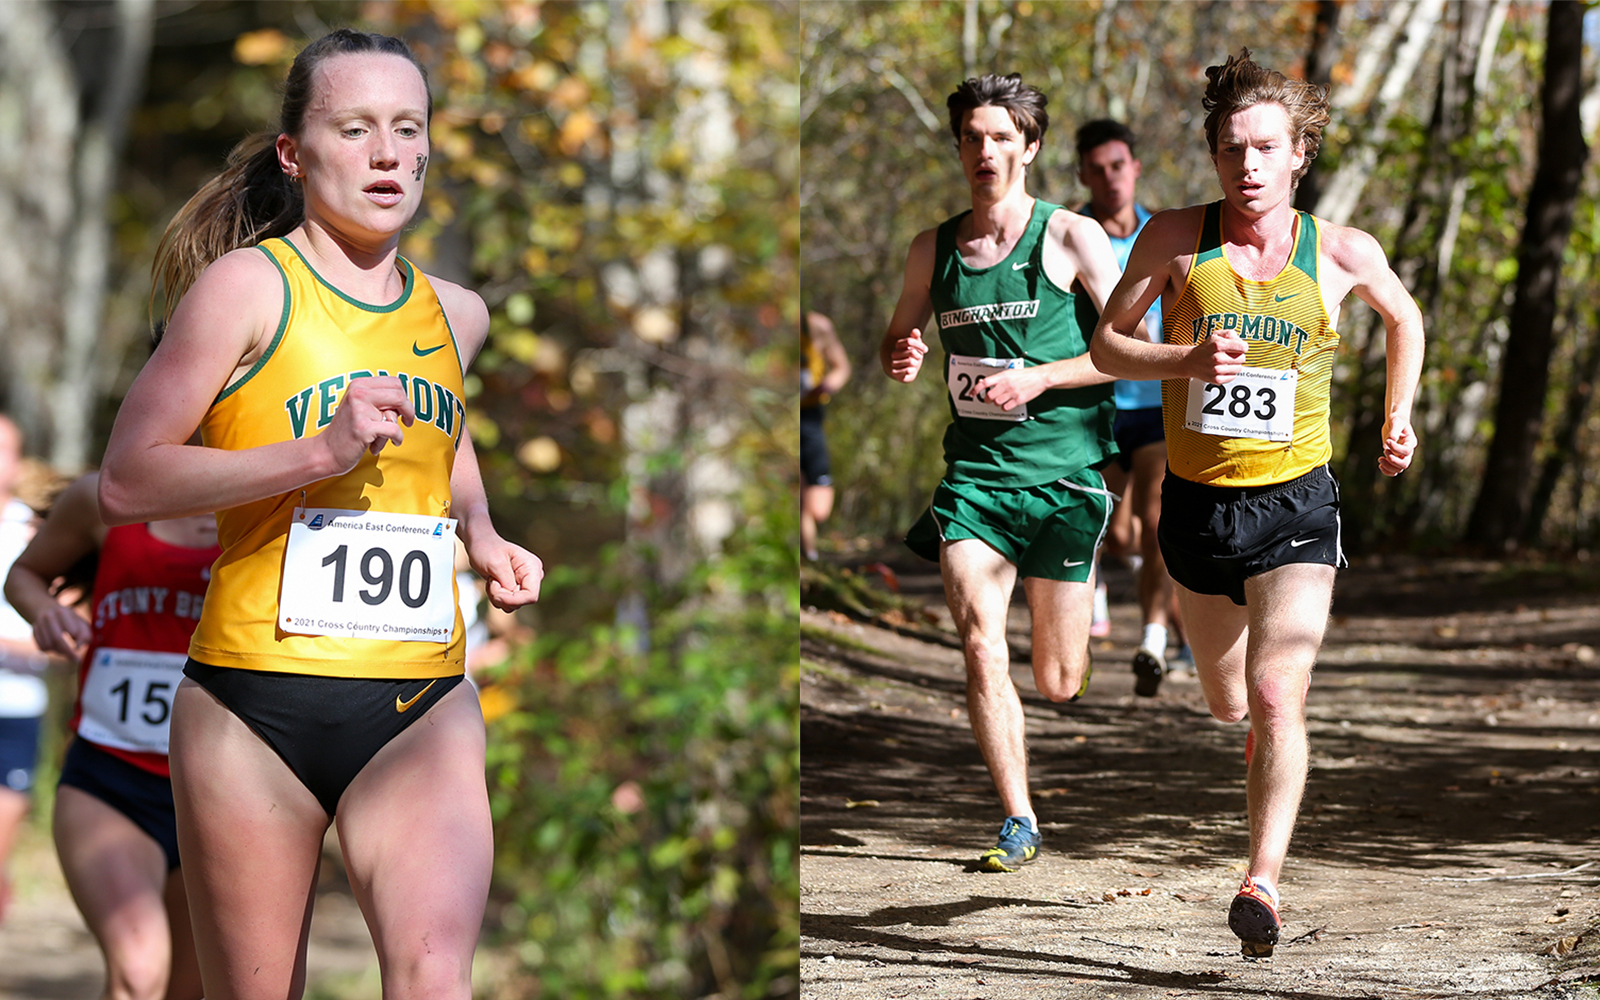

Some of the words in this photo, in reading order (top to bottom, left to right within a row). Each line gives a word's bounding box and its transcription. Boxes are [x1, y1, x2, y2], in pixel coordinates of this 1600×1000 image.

[942, 301, 1037, 328] BINGHAMTON
[1191, 312, 1309, 355] VERMONT
[1245, 371, 1277, 380] Conference
[285, 369, 465, 453] VEONT
[1201, 383, 1277, 421] 283
[1220, 425, 1242, 434] Country
[1243, 426, 1284, 436] Championships
[327, 520, 364, 531] America
[365, 522, 384, 532] East
[385, 523, 431, 535] Conference
[321, 544, 431, 609] 190
[294, 617, 315, 626] 2021
[317, 619, 345, 630] Cross
[346, 621, 380, 633] Country
[382, 623, 442, 636] Championships
[110, 677, 170, 727] 15
